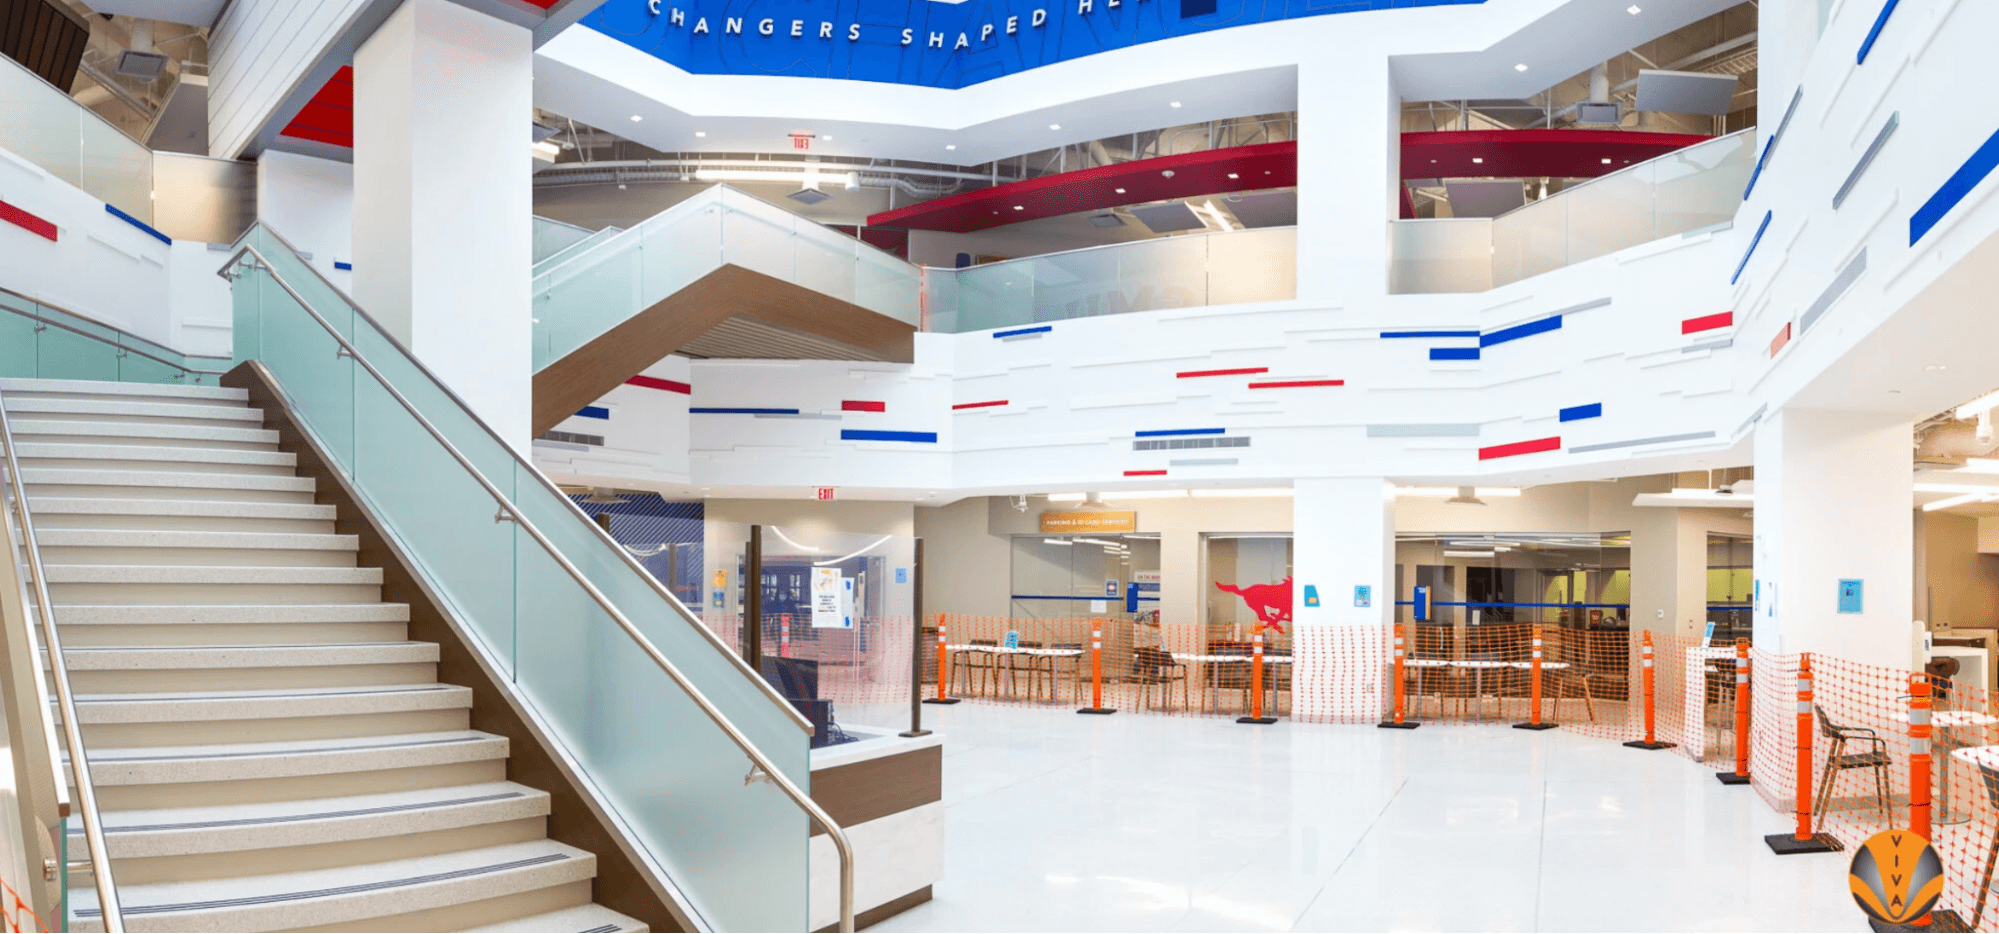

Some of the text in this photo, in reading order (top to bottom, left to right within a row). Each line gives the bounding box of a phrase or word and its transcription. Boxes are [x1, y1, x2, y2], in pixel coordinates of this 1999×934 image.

[648, 0, 1047, 50] CHANGERS SHAPED
[818, 488, 834, 500] EXIT
